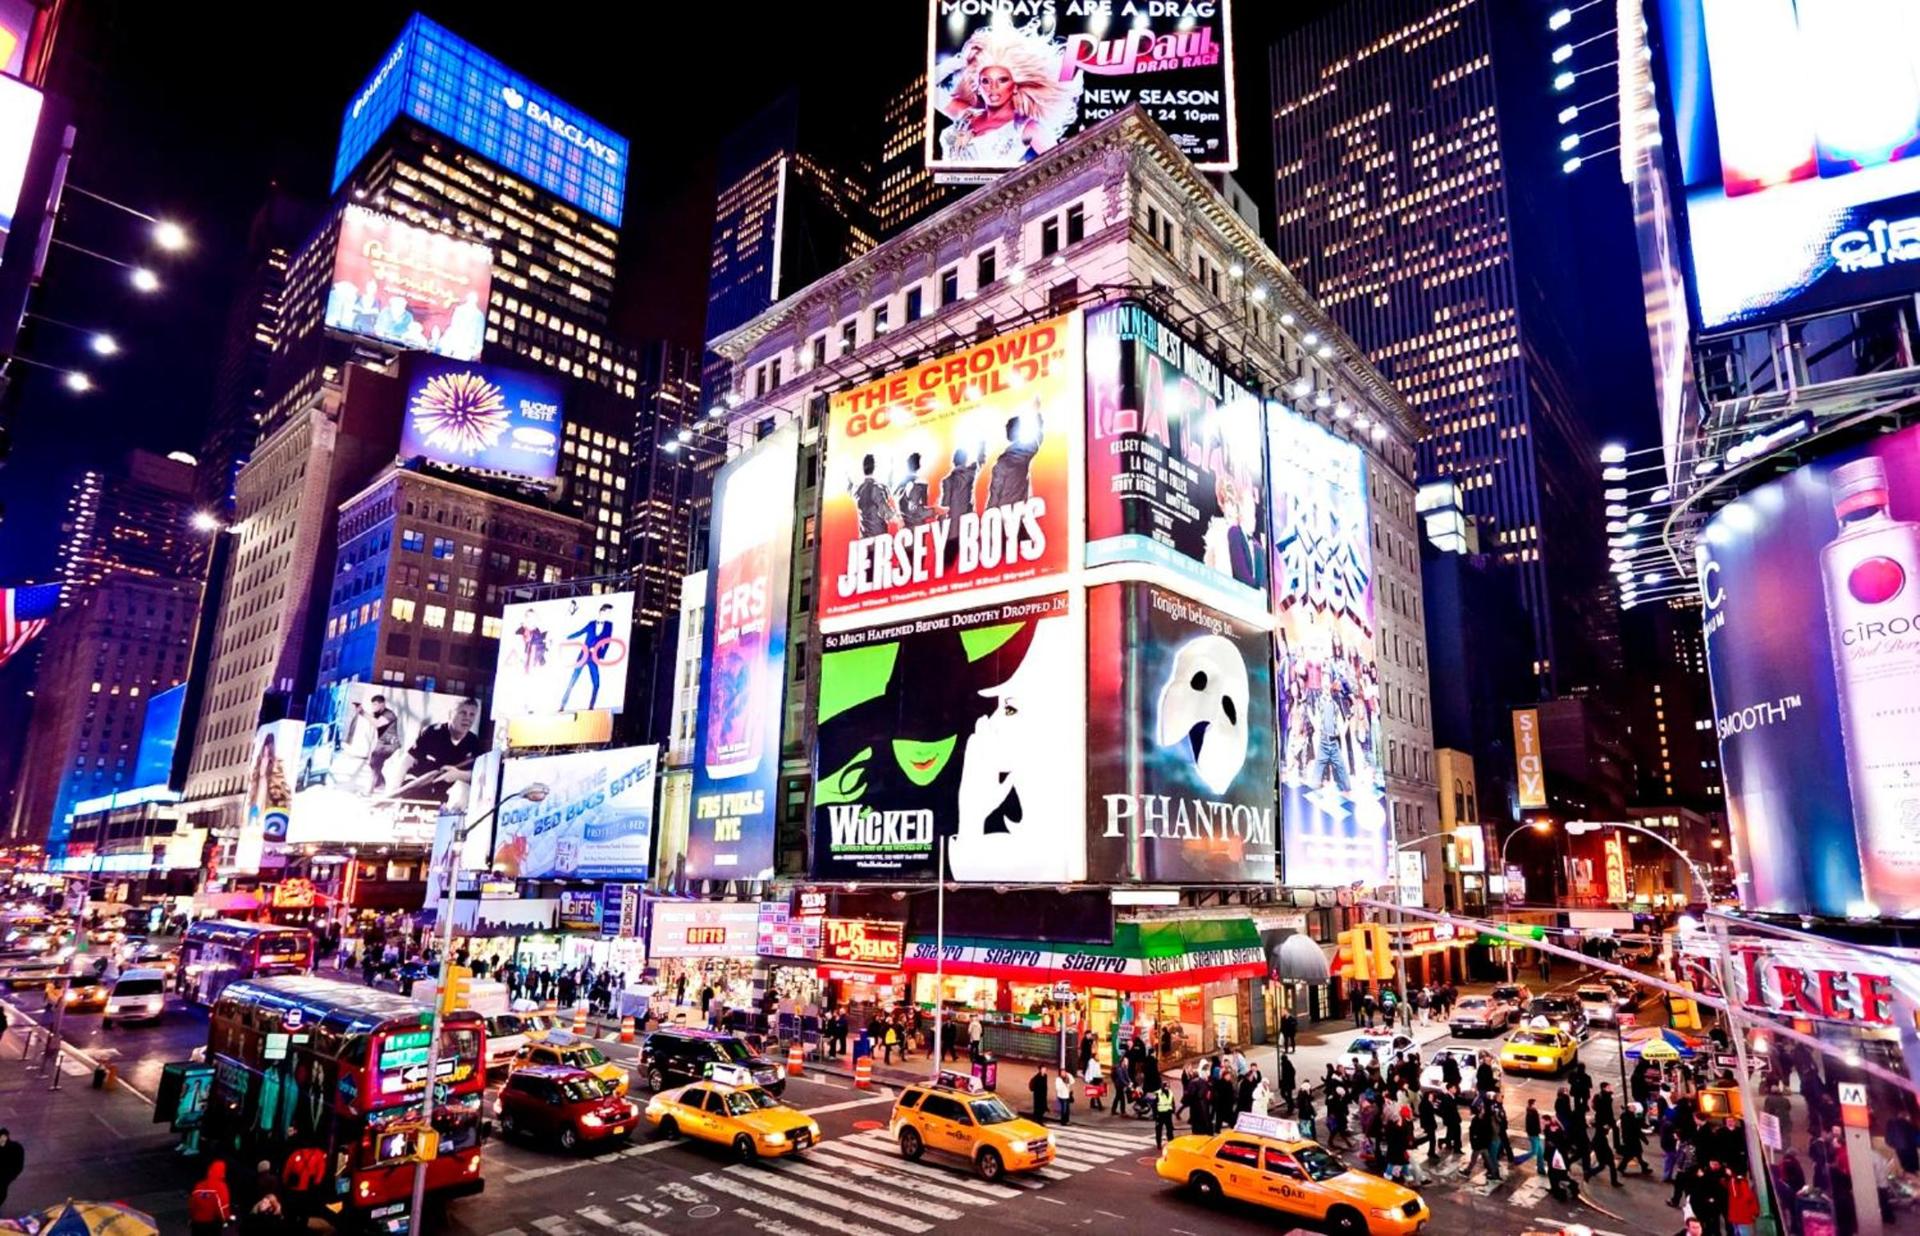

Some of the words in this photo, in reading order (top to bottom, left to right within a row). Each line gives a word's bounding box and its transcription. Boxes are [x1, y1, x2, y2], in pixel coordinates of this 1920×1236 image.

[1066, 0, 1112, 16] ARE
[1122, 1, 1139, 17] A
[1149, 2, 1216, 18] DRAG
[1136, 60, 1178, 74] DRAG
[1183, 54, 1219, 69] RACE
[1084, 89, 1131, 104] NEW
[1139, 90, 1220, 105] SEASON
[1158, 109, 1177, 121] 24
[1183, 110, 1220, 123] 10pm
[525, 100, 618, 165] BARCLAYS
[1157, 322, 1182, 370] BEST
[919, 326, 1057, 392] CROWD
[837, 517, 951, 598] JERSEY
[957, 496, 1047, 574] BOYS
[719, 576, 768, 632] FRS
[1150, 589, 1187, 621] Tonight
[1188, 603, 1223, 636] belongs
[825, 636, 838, 648] SO
[840, 633, 865, 647] MUCH
[867, 625, 914, 641] HAPPENED
[916, 619, 950, 633] BEFORE
[952, 610, 1000, 627] DOROTHY
[1002, 602, 1050, 619] DROPPED
[533, 811, 561, 836] BED
[565, 792, 606, 822] BUGS
[609, 758, 652, 798] BITE!
[697, 794, 721, 819] FRS
[714, 817, 742, 842] NYC
[1102, 793, 1272, 846] PHANTOM
[568, 900, 597, 916] GIFTS
[688, 927, 724, 944] GIFTS
[850, 938, 898, 961] STEAKS
[983, 948, 1041, 967] sbarro
[1193, 949, 1225, 968] sbarro
[1232, 947, 1262, 963] sbarro
[1062, 951, 1128, 973] sbarro
[1149, 954, 1183, 974] sbarro
